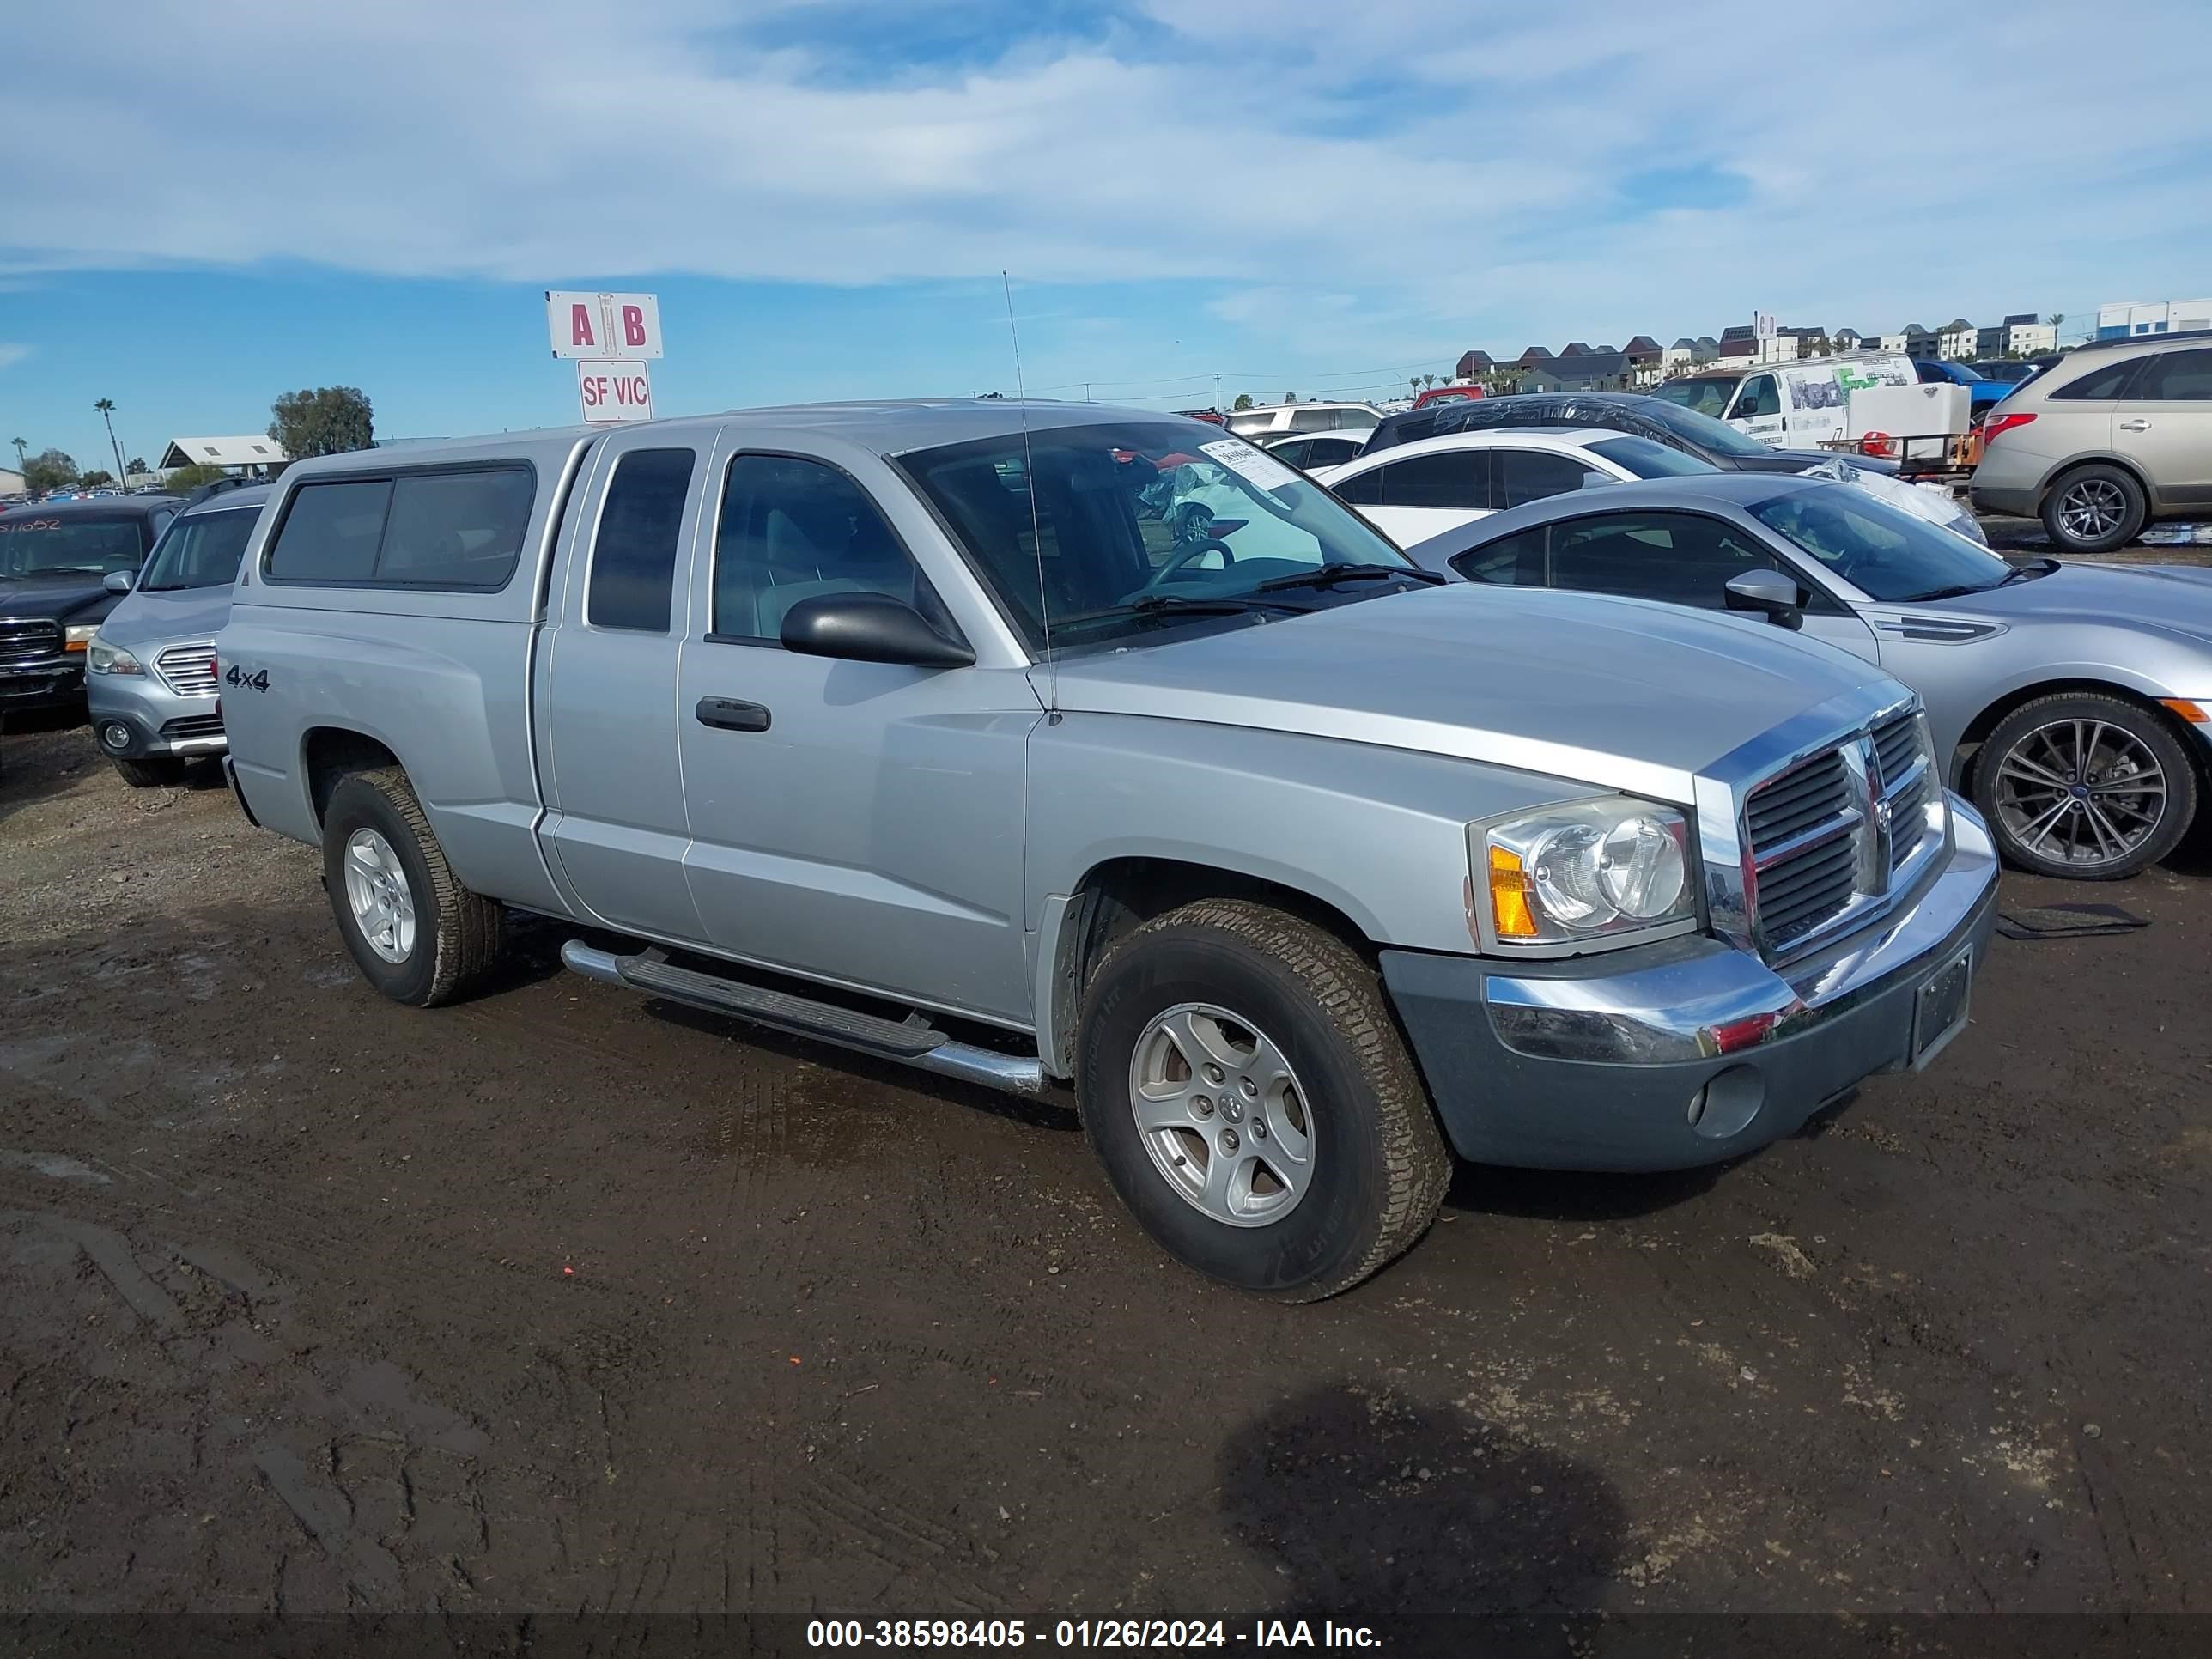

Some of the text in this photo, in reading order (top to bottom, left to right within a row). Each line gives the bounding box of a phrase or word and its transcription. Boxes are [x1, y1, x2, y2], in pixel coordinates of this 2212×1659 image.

[572, 304, 646, 346] A B
[583, 376, 647, 406] SF VIC
[226, 665, 271, 693] 4x4
